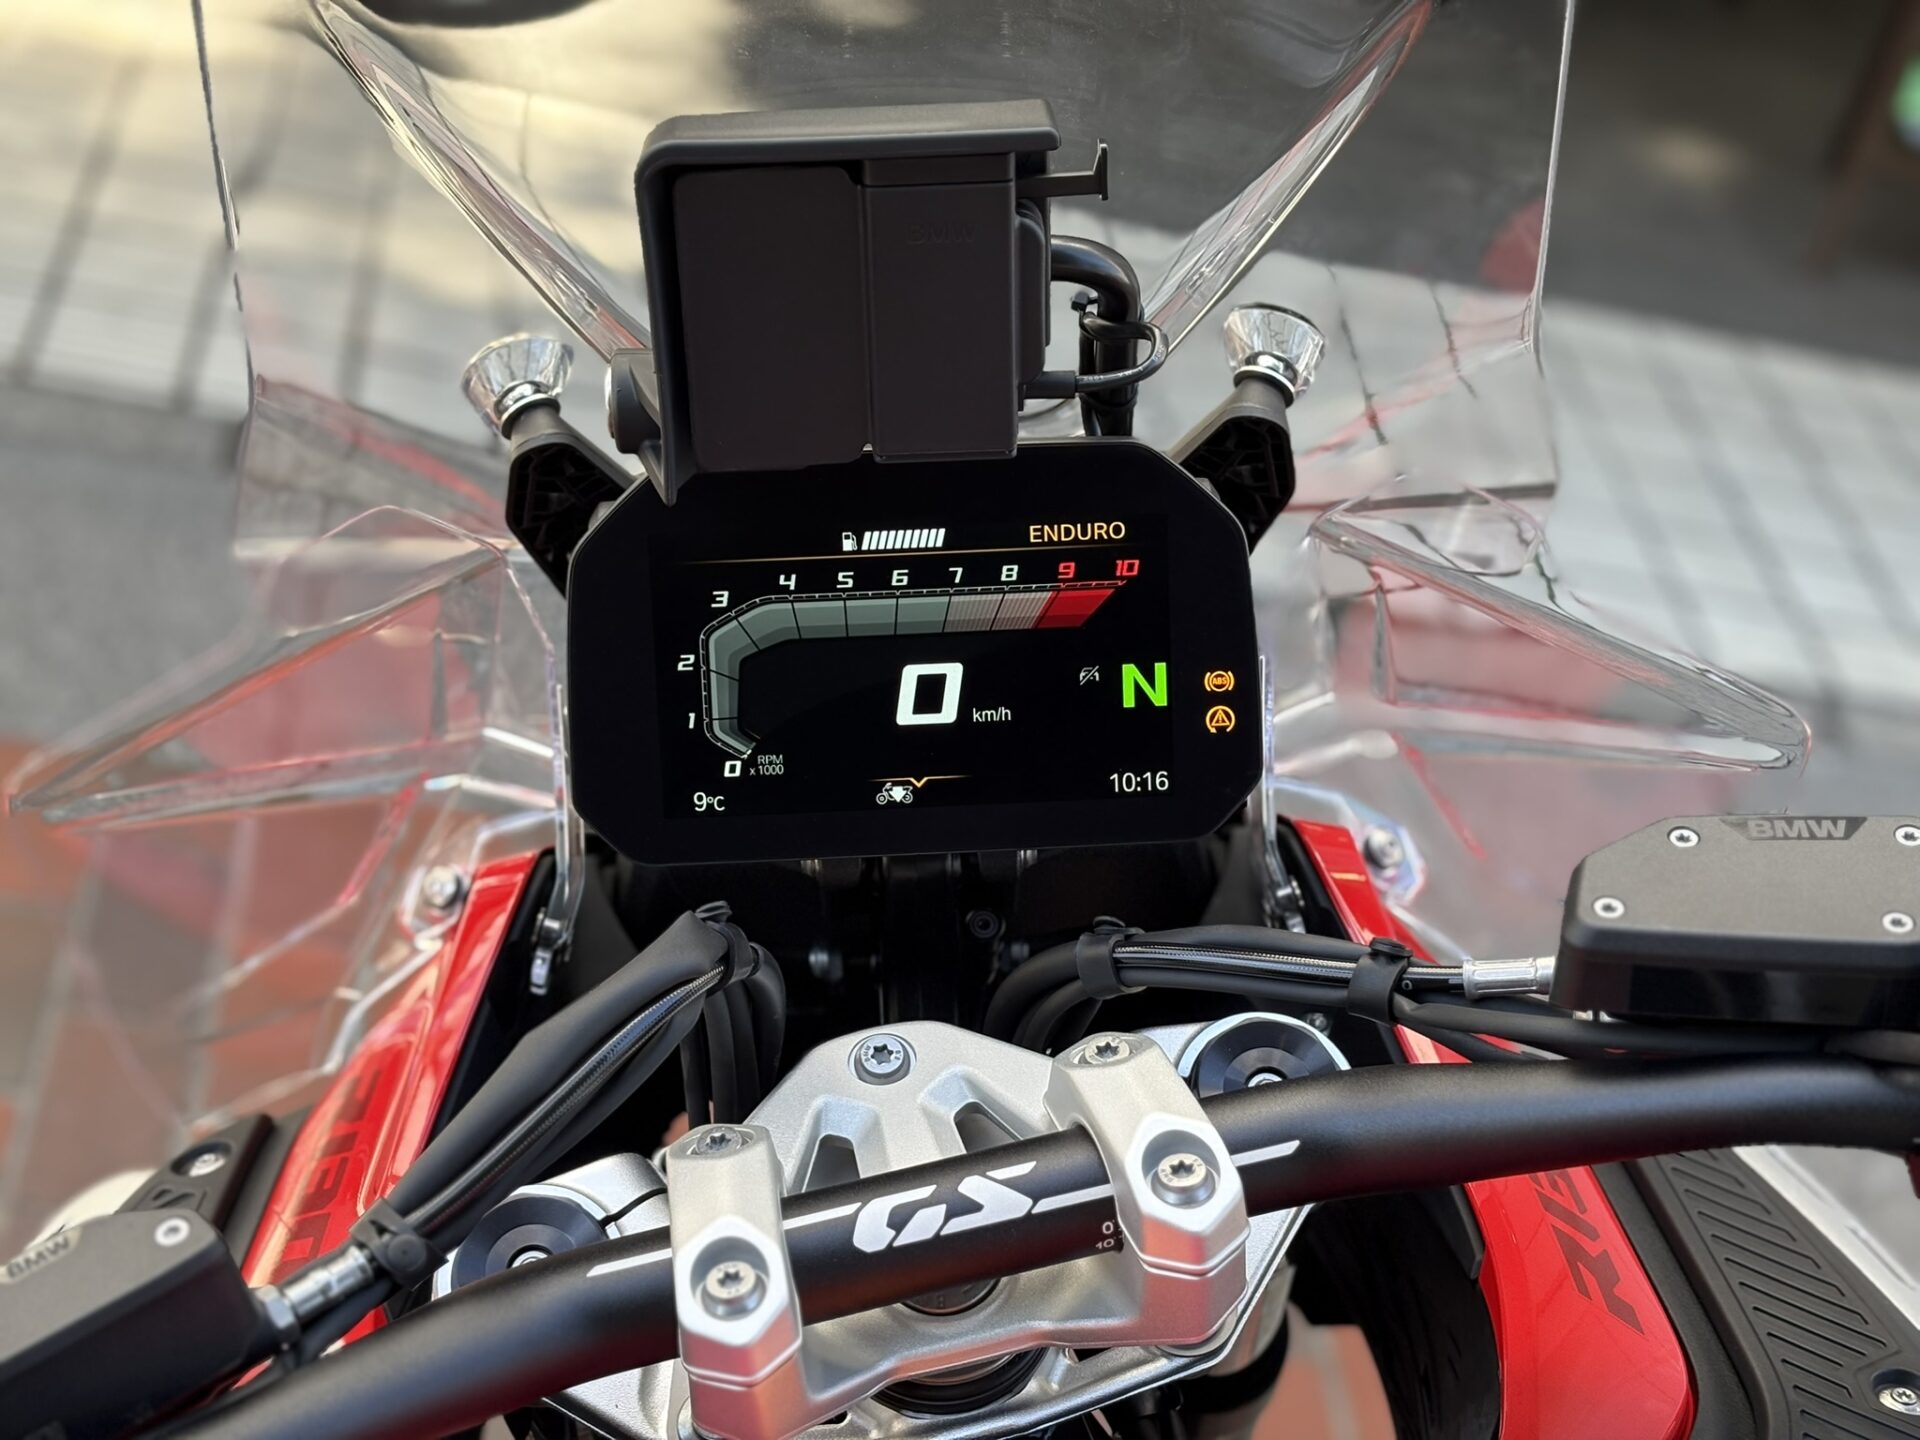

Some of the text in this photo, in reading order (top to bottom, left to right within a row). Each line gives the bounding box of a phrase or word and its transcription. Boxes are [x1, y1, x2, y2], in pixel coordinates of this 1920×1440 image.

[1029, 521, 1126, 543] ENDURO
[948, 566, 963, 584] 7
[1000, 564, 1019, 582] 8
[1057, 561, 1076, 579] 9
[1115, 559, 1140, 577] 10
[779, 573, 797, 591] 4
[836, 572, 855, 589] 5
[890, 569, 909, 588] 6
[710, 590, 730, 609] 3
[677, 653, 695, 671] 2
[895, 662, 964, 726] 0
[1121, 661, 1168, 709] N
[688, 712, 696, 730] 1
[972, 705, 1012, 724] km/h
[757, 753, 784, 765] RPM
[723, 760, 742, 778] 0
[758, 763, 785, 776] 1000
[1109, 769, 1169, 793] 10:16
[1747, 819, 1847, 839] BMW
[852, 1160, 1038, 1252] GS
[6, 1235, 70, 1279] BMW
